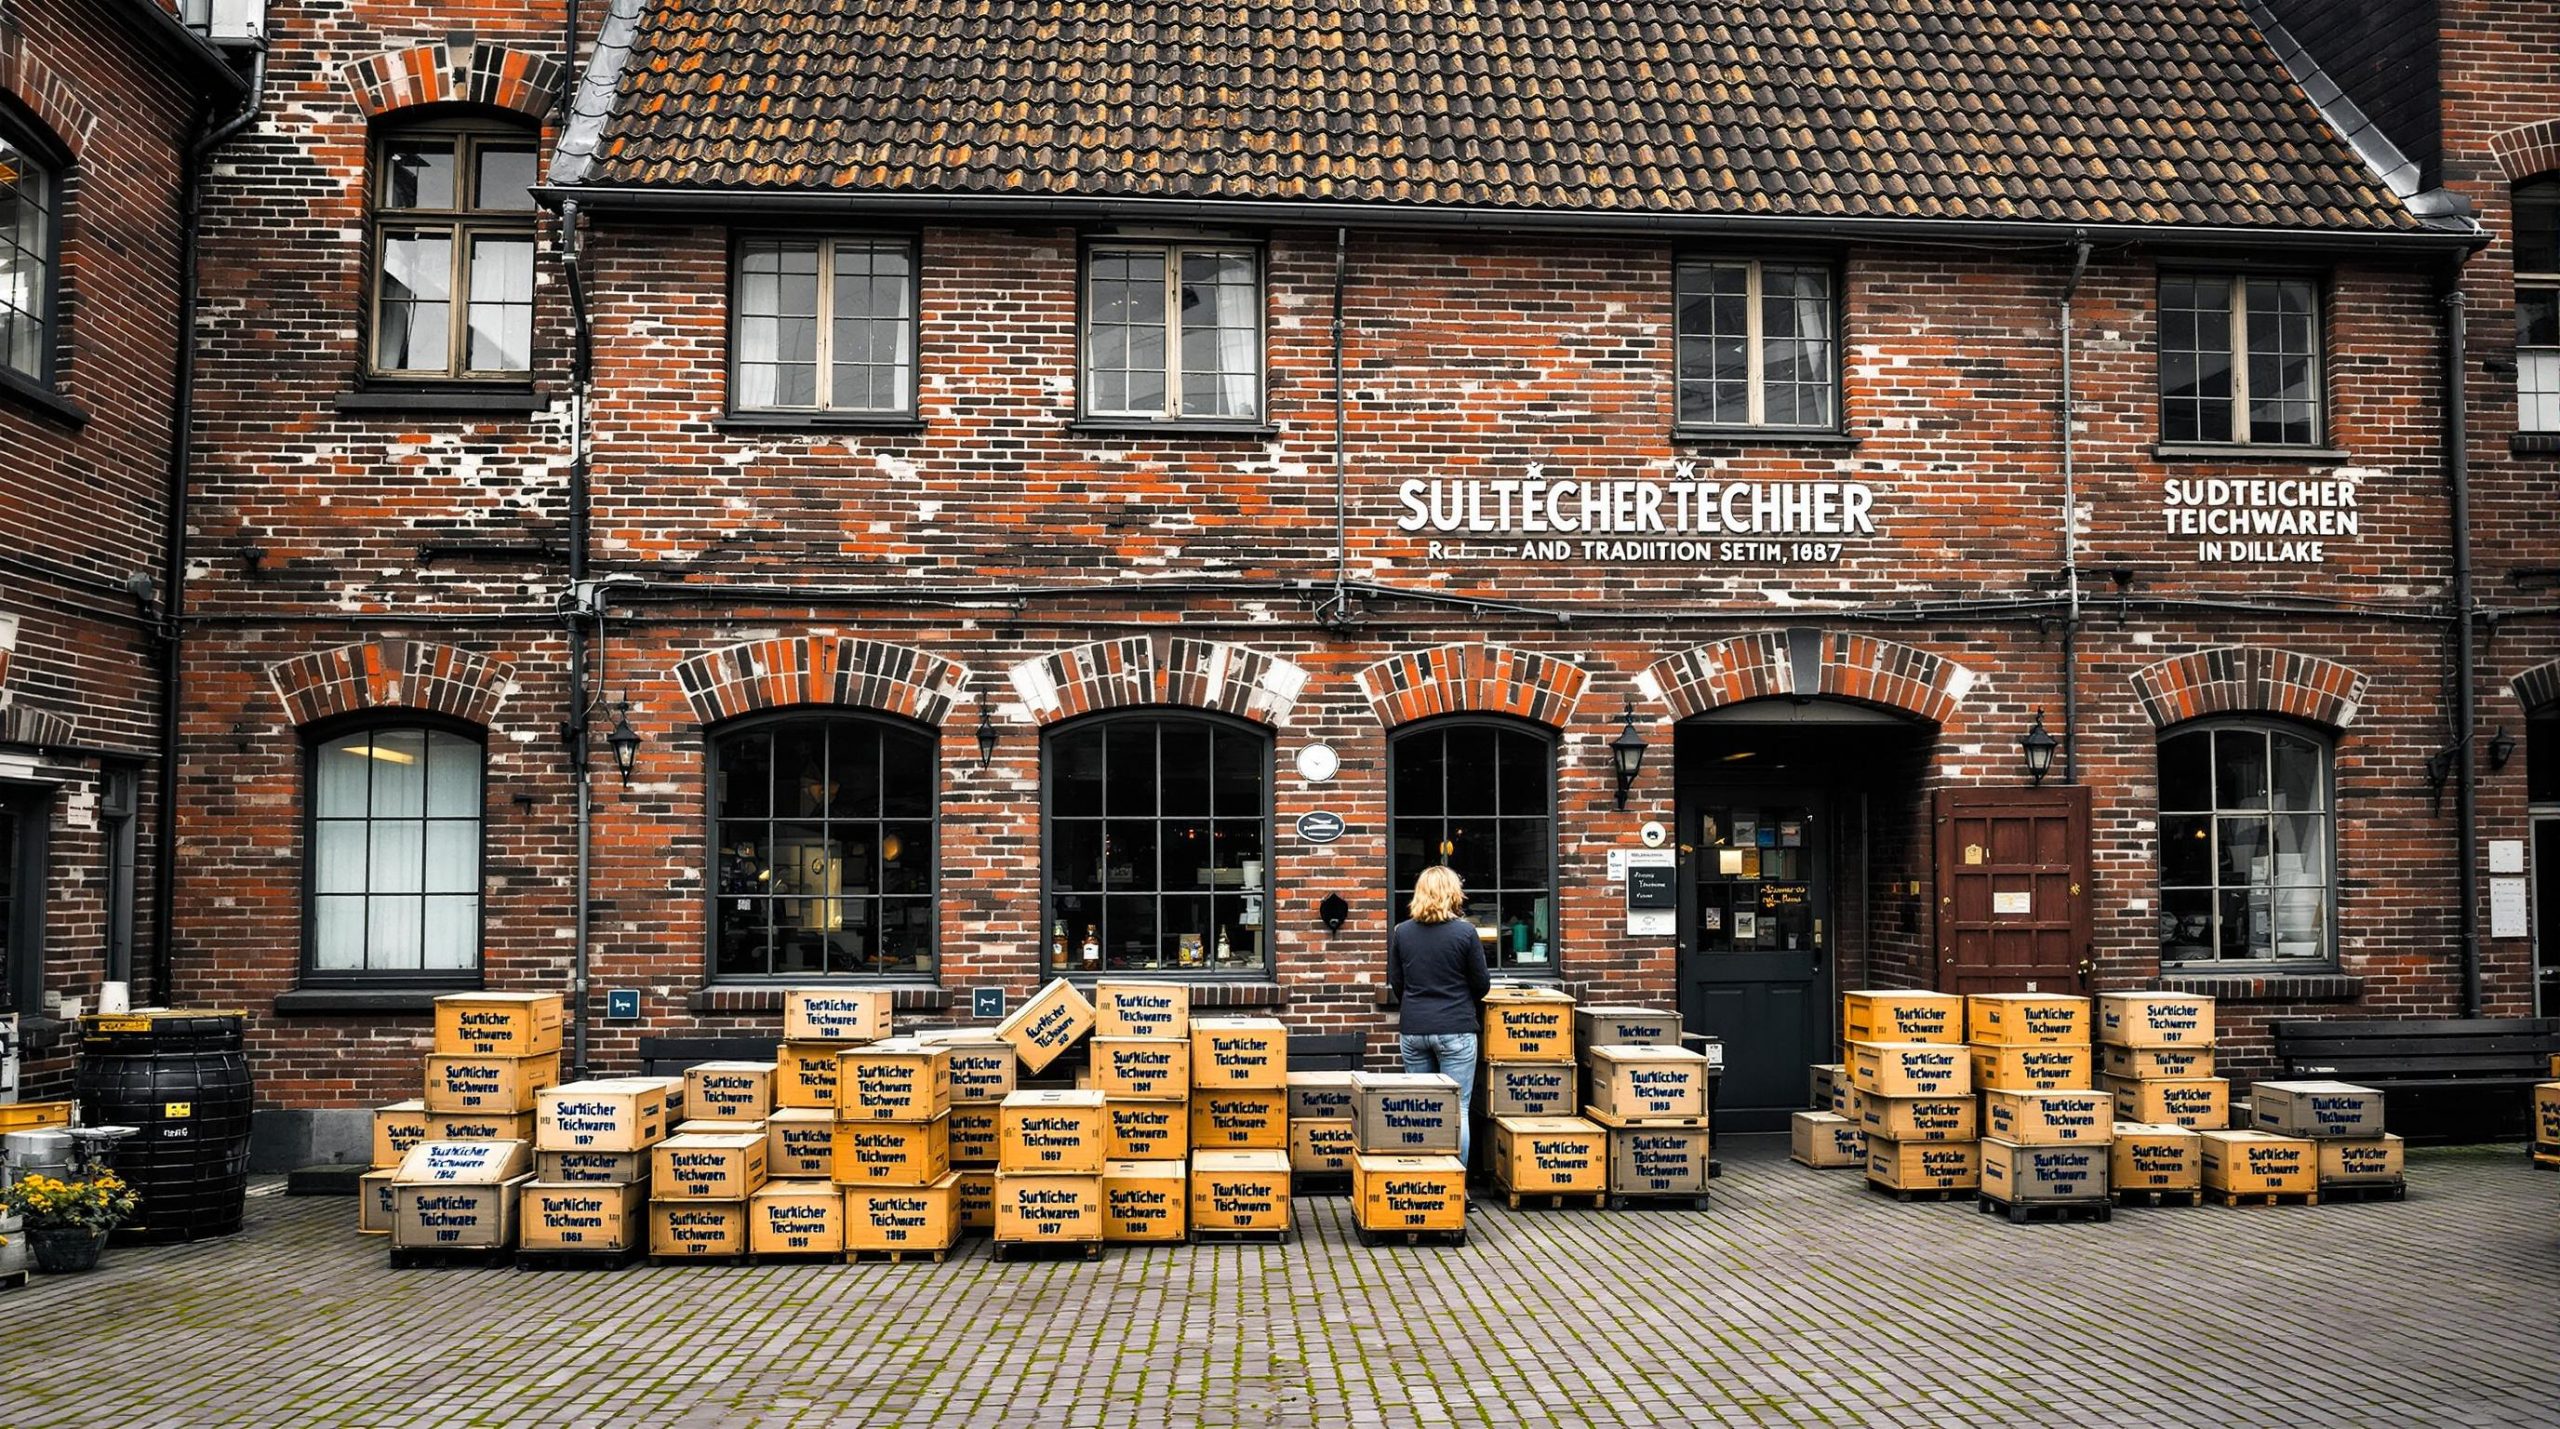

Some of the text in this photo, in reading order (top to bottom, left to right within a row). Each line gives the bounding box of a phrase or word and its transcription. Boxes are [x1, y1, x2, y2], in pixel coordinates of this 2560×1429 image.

[2163, 478, 2357, 506] SUDTEICHER
[2162, 508, 2358, 536] TEICHWAREN
[2199, 541, 2324, 562] IN DILLAKE
